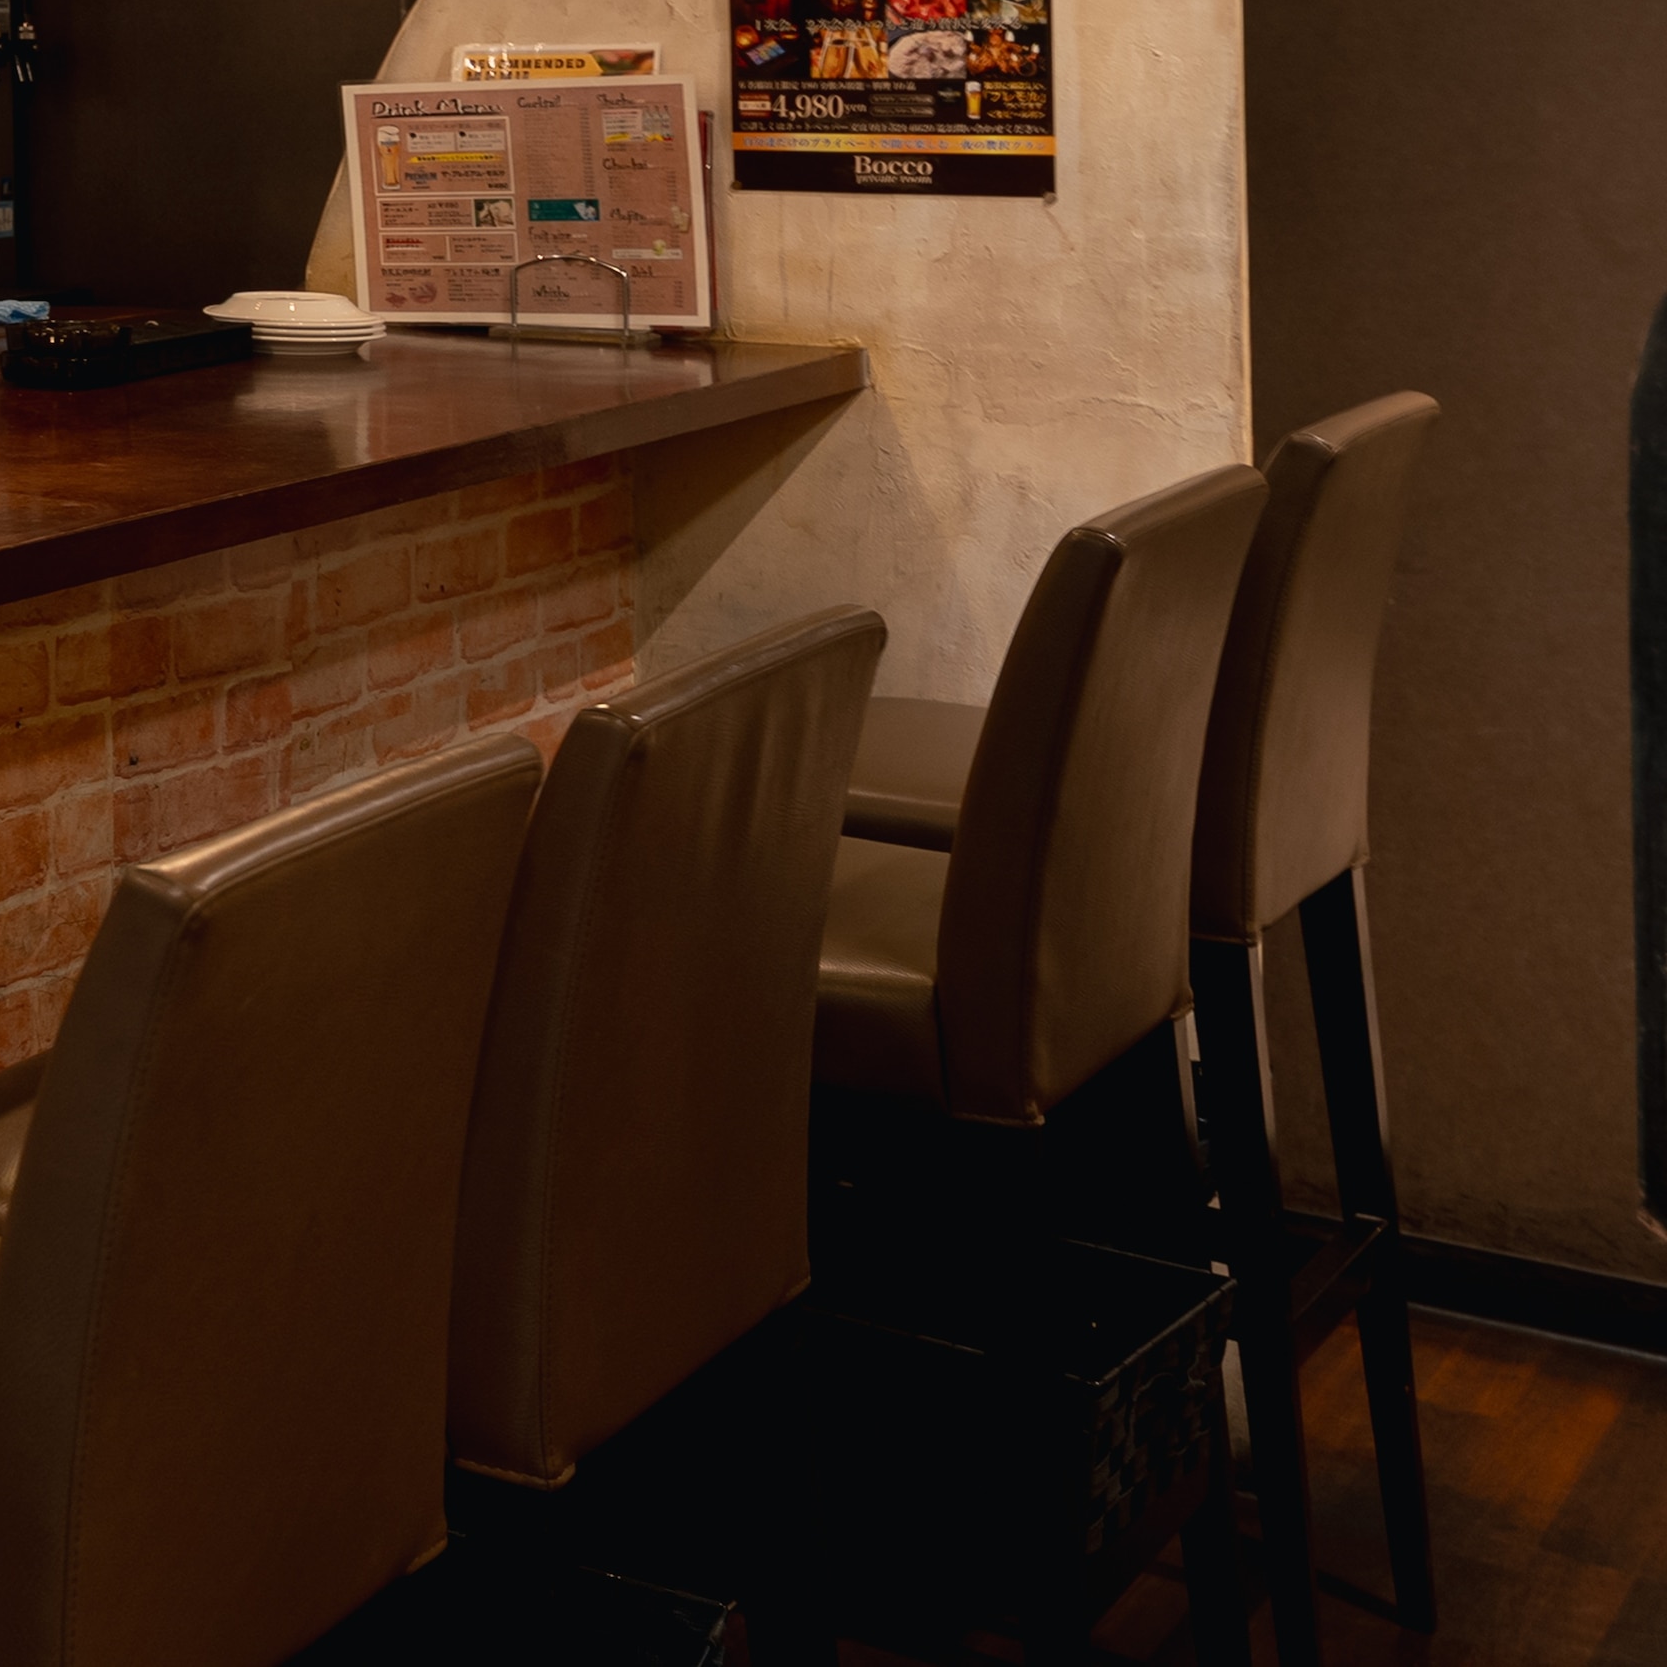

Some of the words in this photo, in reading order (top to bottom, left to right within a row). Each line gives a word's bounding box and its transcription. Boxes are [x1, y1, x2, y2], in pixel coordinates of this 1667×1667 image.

[372, 100, 428, 116] Drink
[436, 98, 503, 114] Menu
[772, 93, 844, 121] 4,980
[854, 155, 933, 175] Bocco
